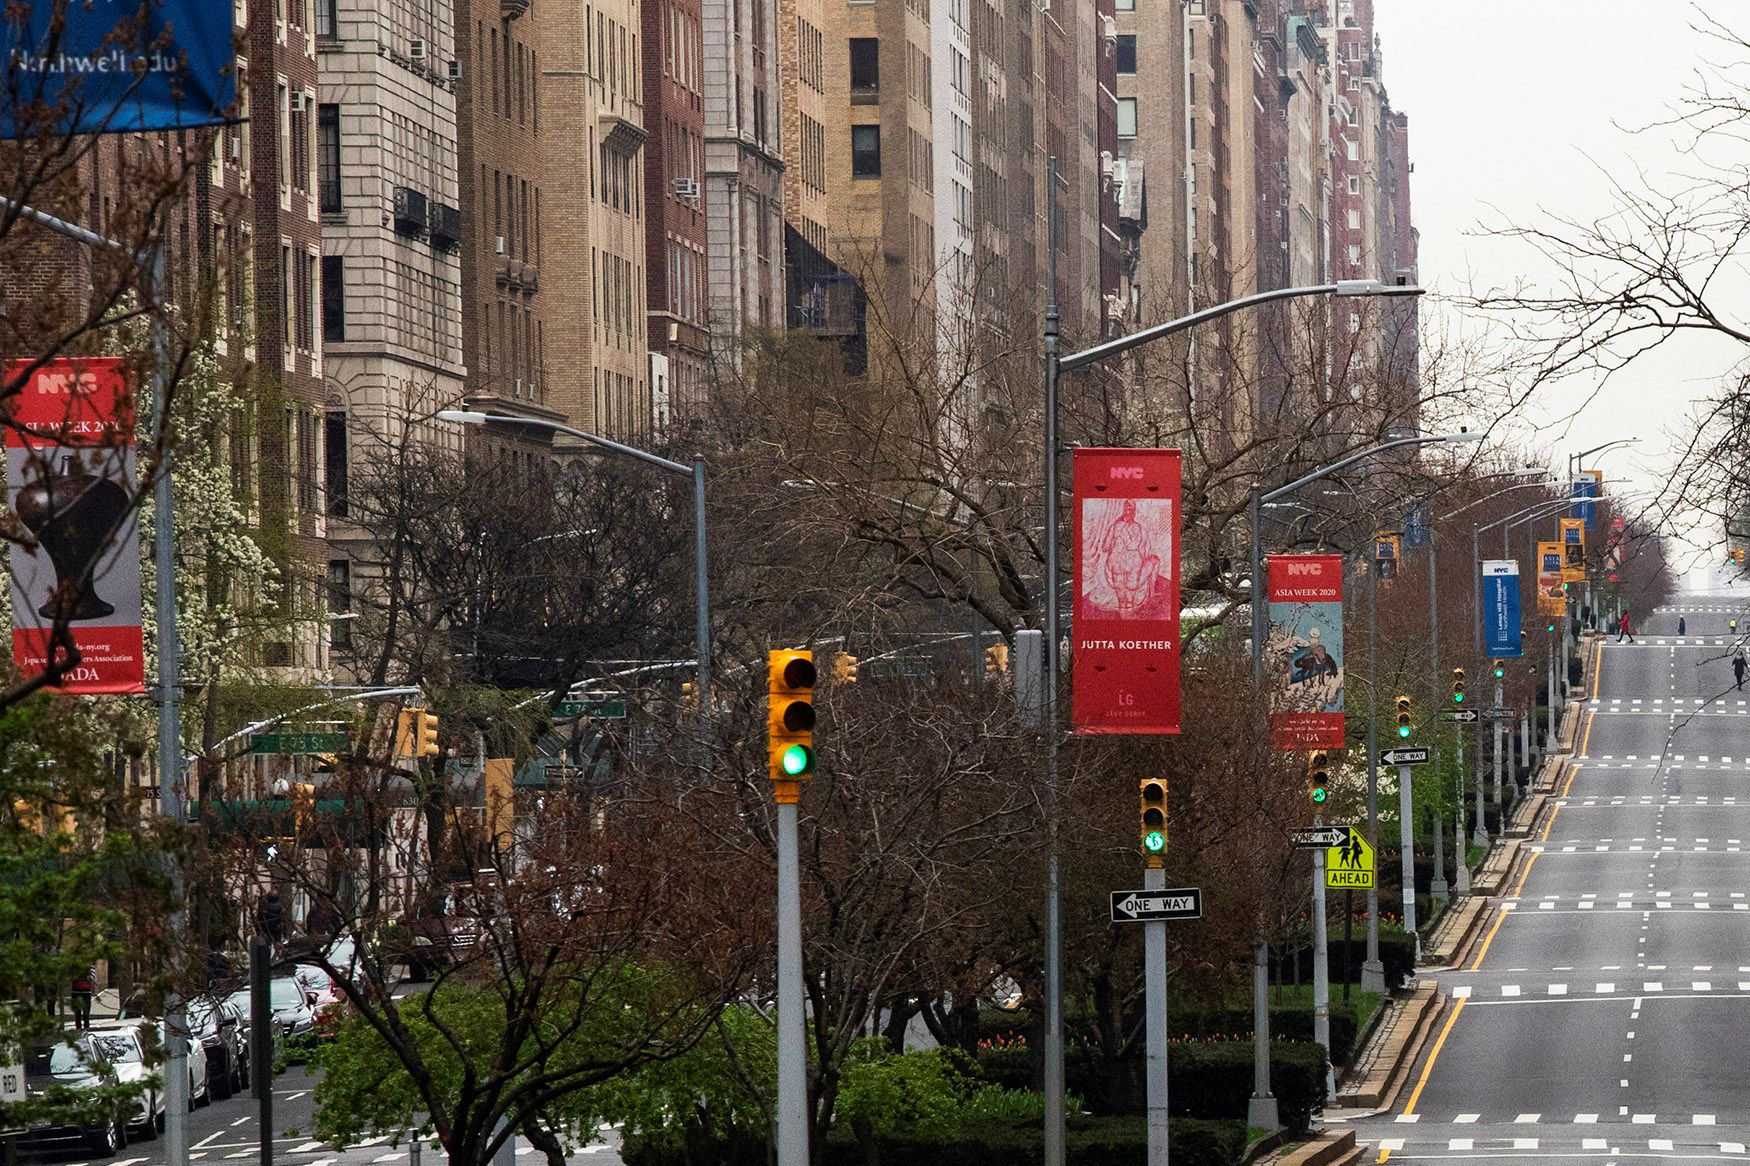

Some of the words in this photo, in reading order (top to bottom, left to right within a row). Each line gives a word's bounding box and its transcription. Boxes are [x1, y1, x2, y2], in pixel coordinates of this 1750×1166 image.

[1110, 467, 1144, 479] NYC
[1287, 563, 1322, 576] NYC
[1275, 588, 1293, 596] ASIA
[1293, 588, 1318, 596] WEEK
[1081, 640, 1115, 650] JUTTA
[1119, 640, 1172, 650] KOETHER
[1322, 833, 1341, 842] WAY
[1331, 873, 1369, 884] AHEAD
[1125, 900, 1151, 911] ONE
[1162, 898, 1188, 910] WAY
